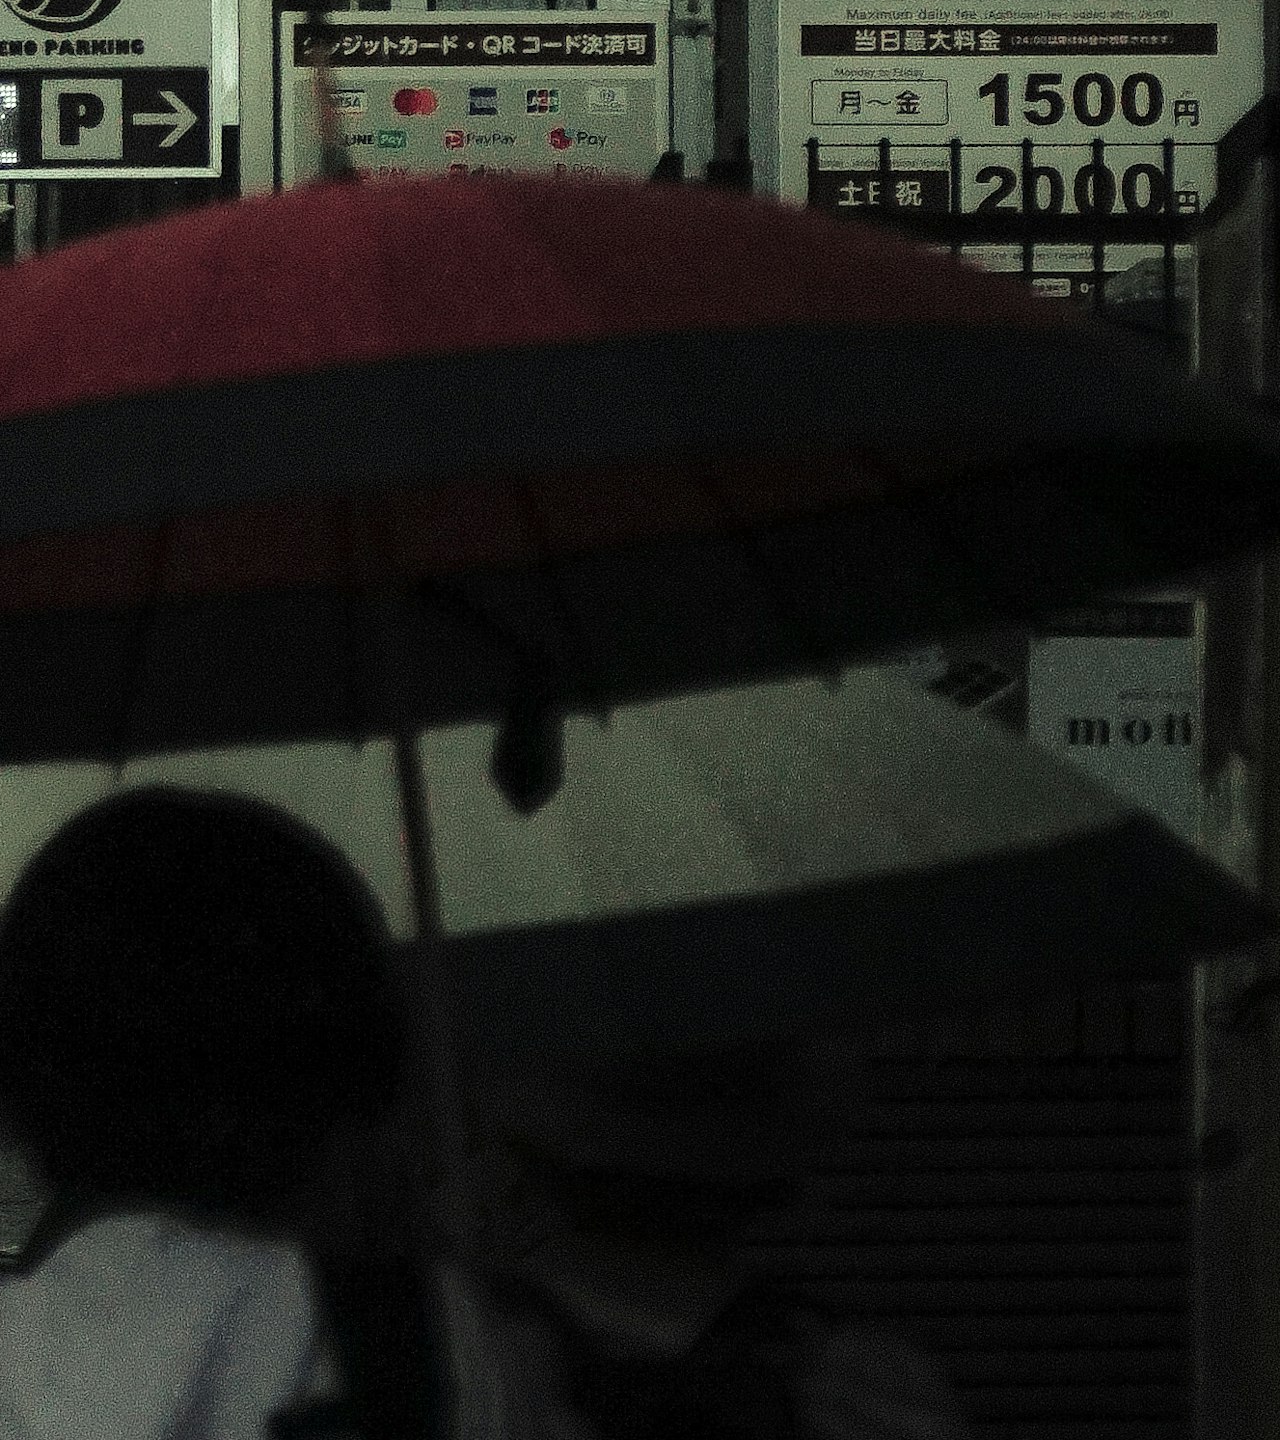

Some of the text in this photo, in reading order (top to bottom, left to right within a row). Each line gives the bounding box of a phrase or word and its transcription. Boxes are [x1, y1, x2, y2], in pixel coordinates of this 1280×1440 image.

[44, 38, 146, 56] PARKING
[853, 28, 1002, 52] 当日最大料金
[56, 92, 106, 146] P
[576, 131, 607, 148] Pay
